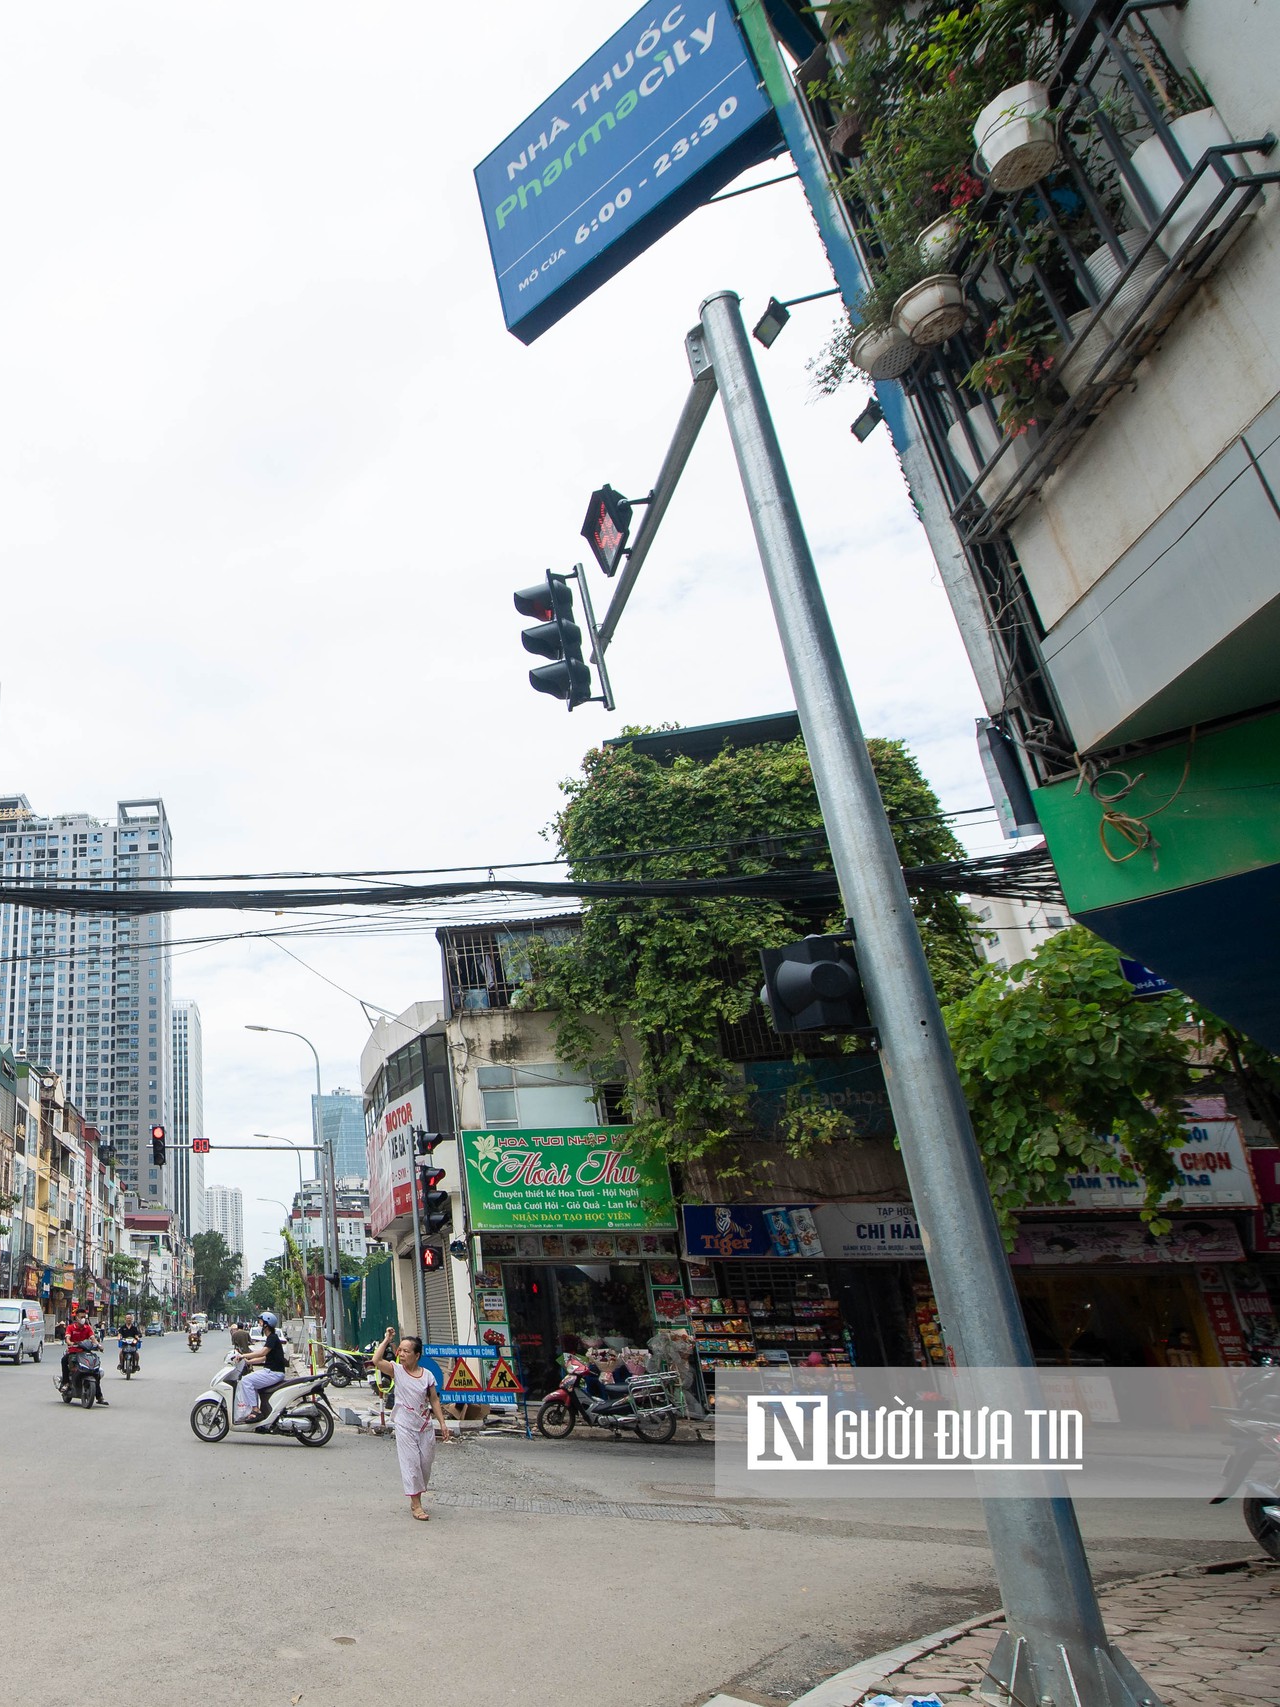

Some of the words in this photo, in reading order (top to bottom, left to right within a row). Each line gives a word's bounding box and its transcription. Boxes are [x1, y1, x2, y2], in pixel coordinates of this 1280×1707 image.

[506, 116, 570, 181] NHÀ
[571, 3, 688, 116] THUỐC
[493, 11, 718, 231] Pharmacity
[517, 266, 539, 292] MỞ
[540, 247, 567, 274] CỬA
[574, 186, 633, 245] 6:00
[652, 96, 739, 177] 23:30
[385, 1102, 413, 1133] MOTOR
[498, 1137, 528, 1147] HOA
[531, 1135, 564, 1147] TƯƠI
[568, 1132, 608, 1148] NHẬP
[492, 1150, 571, 1187] Hoài
[575, 1149, 640, 1185] Thu
[1181, 1152, 1232, 1173] CHỌN
[493, 1189, 524, 1199] Chuyên
[525, 1188, 544, 1198] thiết
[546, 1187, 556, 1198] kế
[558, 1189, 575, 1197] Hoa
[576, 1188, 595, 1197] Tươi
[602, 1188, 617, 1199] Hội
[619, 1188, 639, 1200] Nghị
[482, 1201, 504, 1210] Mâm
[505, 1200, 522, 1211] Quả
[524, 1200, 543, 1210] Cưới
[545, 1200, 559, 1210] Hỏi
[566, 1200, 581, 1210] Giỏ
[582, 1200, 600, 1211] Quả
[608, 1201, 624, 1209] Lan
[877, 1207, 894, 1218] TẠP
[512, 1211, 539, 1223] NHẬN
[541, 1210, 562, 1221] ĐÀO
[564, 1212, 583, 1223] TẠO
[584, 1212, 605, 1223] HỌC
[607, 1210, 631, 1221] VIÊN
[856, 1224, 885, 1244] CHỊ
[701, 1234, 752, 1255] Tiger
[425, 1346, 439, 1355] CÔNG
[439, 1346, 458, 1355] TRƯỜNG
[459, 1347, 472, 1355] ĐANG
[481, 1347, 495, 1355] CÔNG
[454, 1378, 473, 1388] CHẬM
[468, 1394, 475, 1403] SỰ
[487, 1393, 499, 1403] TIỆN
